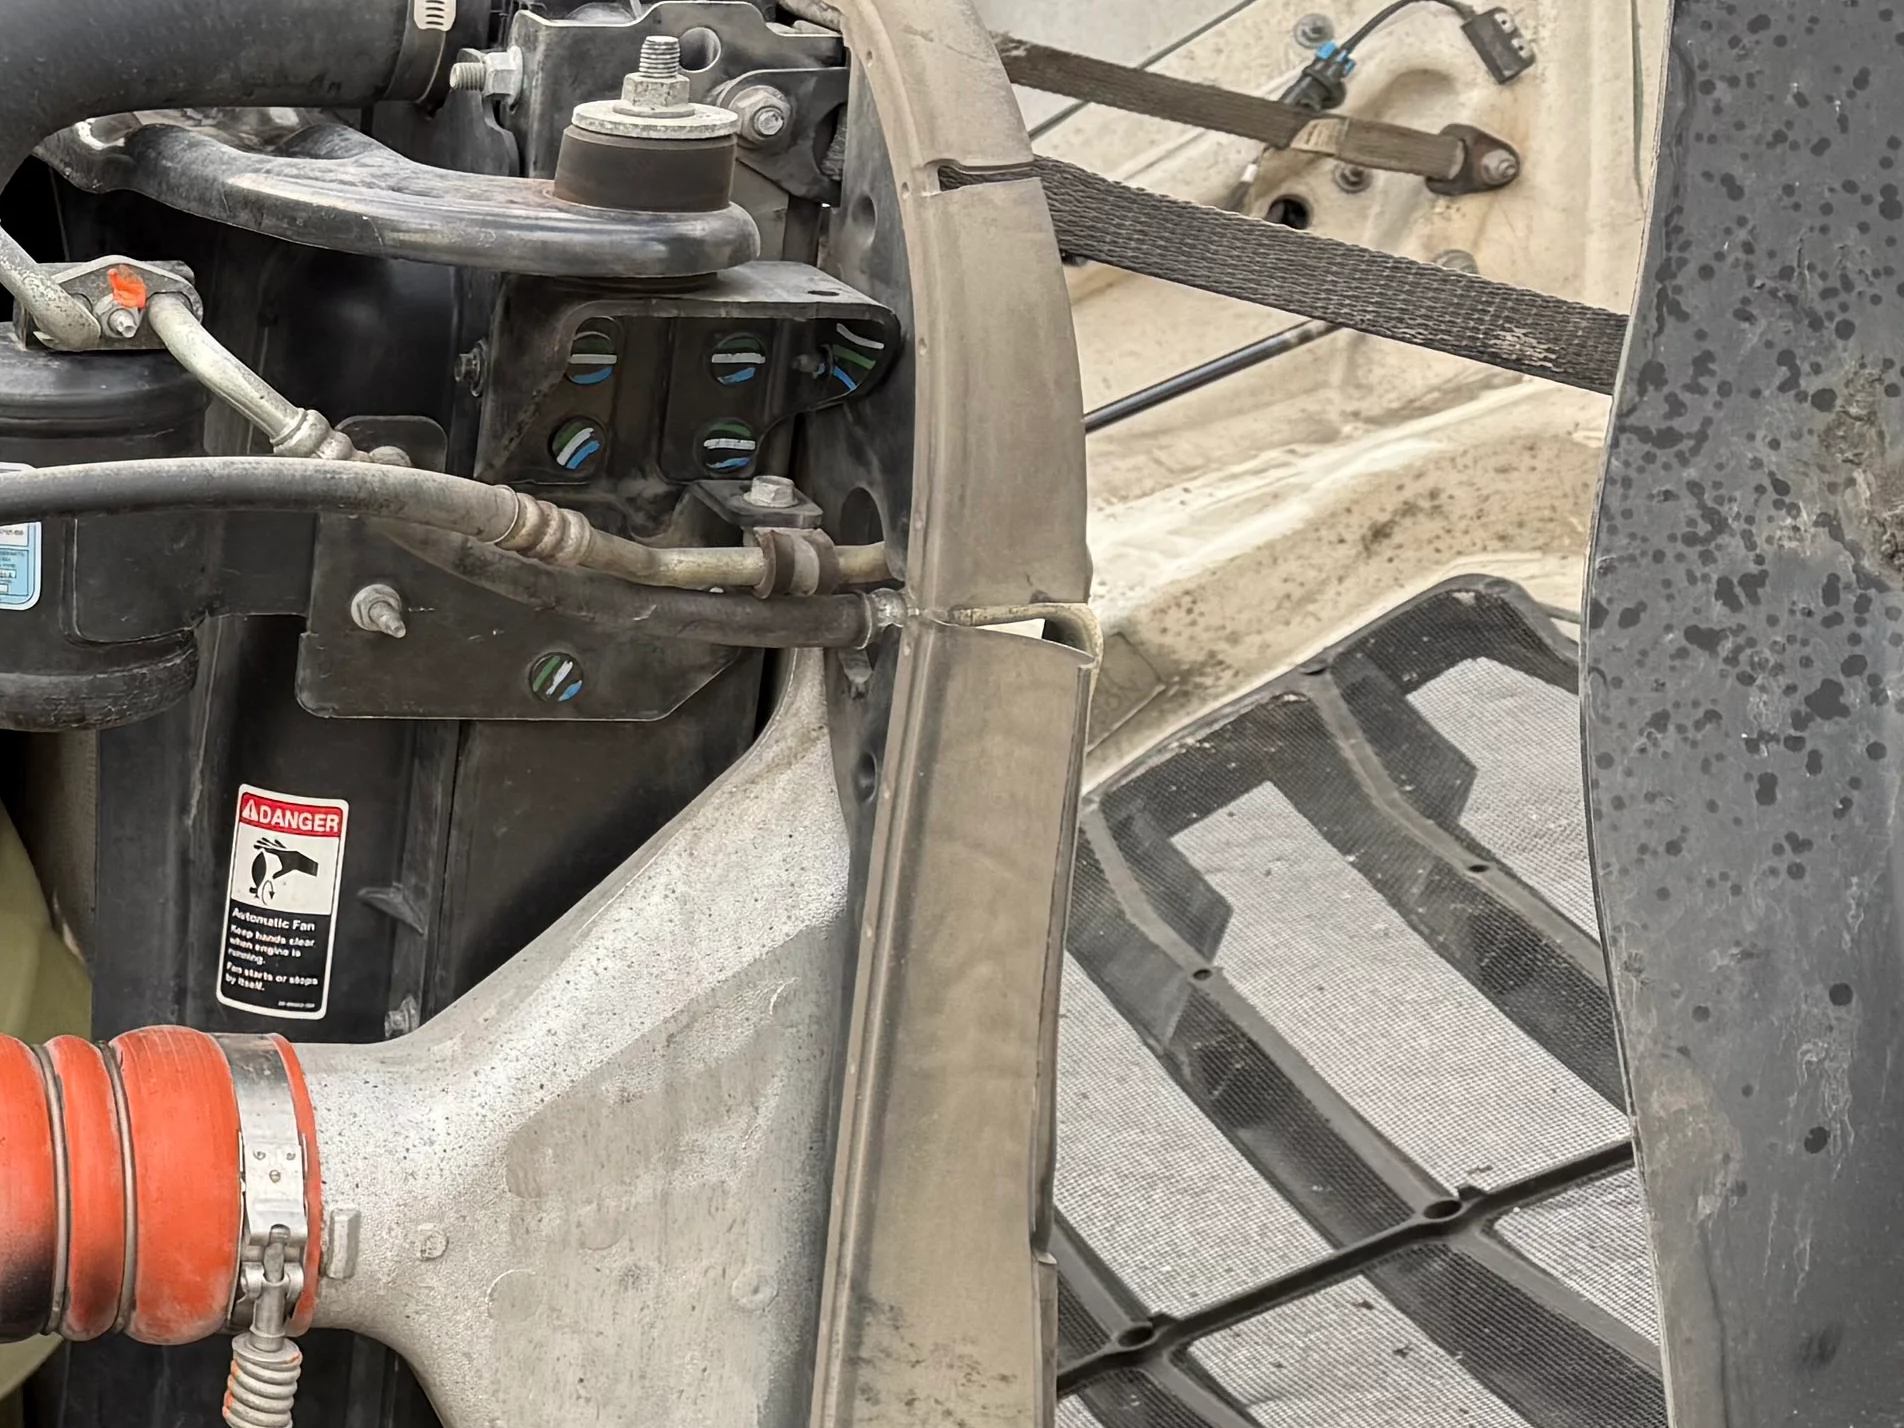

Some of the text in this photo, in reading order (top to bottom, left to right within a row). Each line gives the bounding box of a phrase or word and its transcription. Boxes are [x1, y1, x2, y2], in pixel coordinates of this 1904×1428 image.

[259, 805, 340, 834] DANGER
[232, 907, 316, 931] Automatic Fan
[230, 923, 254, 939] Keep
[255, 930, 287, 945] hands
[229, 936, 253, 950] when
[254, 943, 290, 957] engine
[225, 972, 236, 985] by
[226, 961, 319, 987] Fan starts or stops
